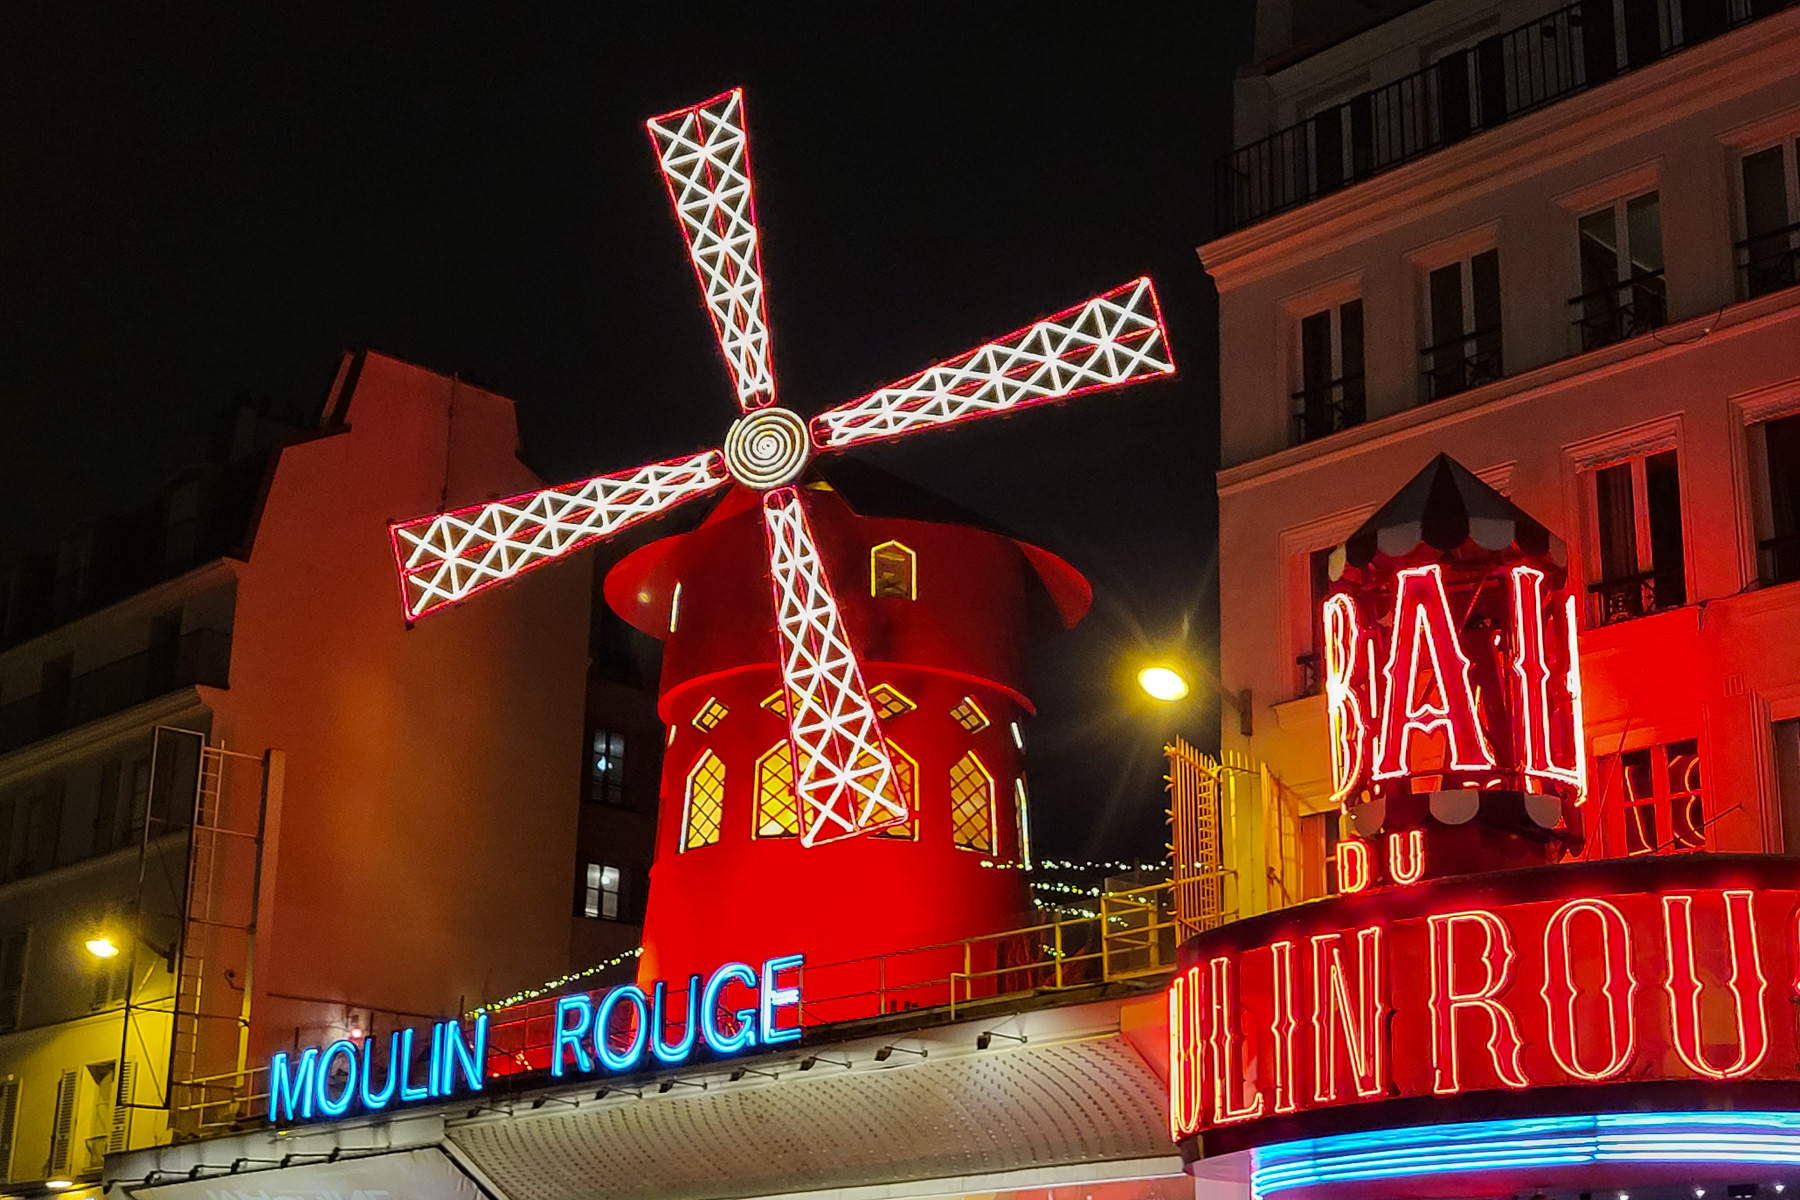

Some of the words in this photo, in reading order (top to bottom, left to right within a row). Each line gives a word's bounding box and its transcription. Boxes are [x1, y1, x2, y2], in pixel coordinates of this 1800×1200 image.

[1323, 564, 1588, 807] BAL
[1337, 830, 1422, 893] DU
[268, 1013, 488, 1123] MOULIN
[551, 953, 804, 1077] ROUGE
[1169, 929, 1382, 1143] ULIN
[1427, 890, 1800, 1094] ROU
